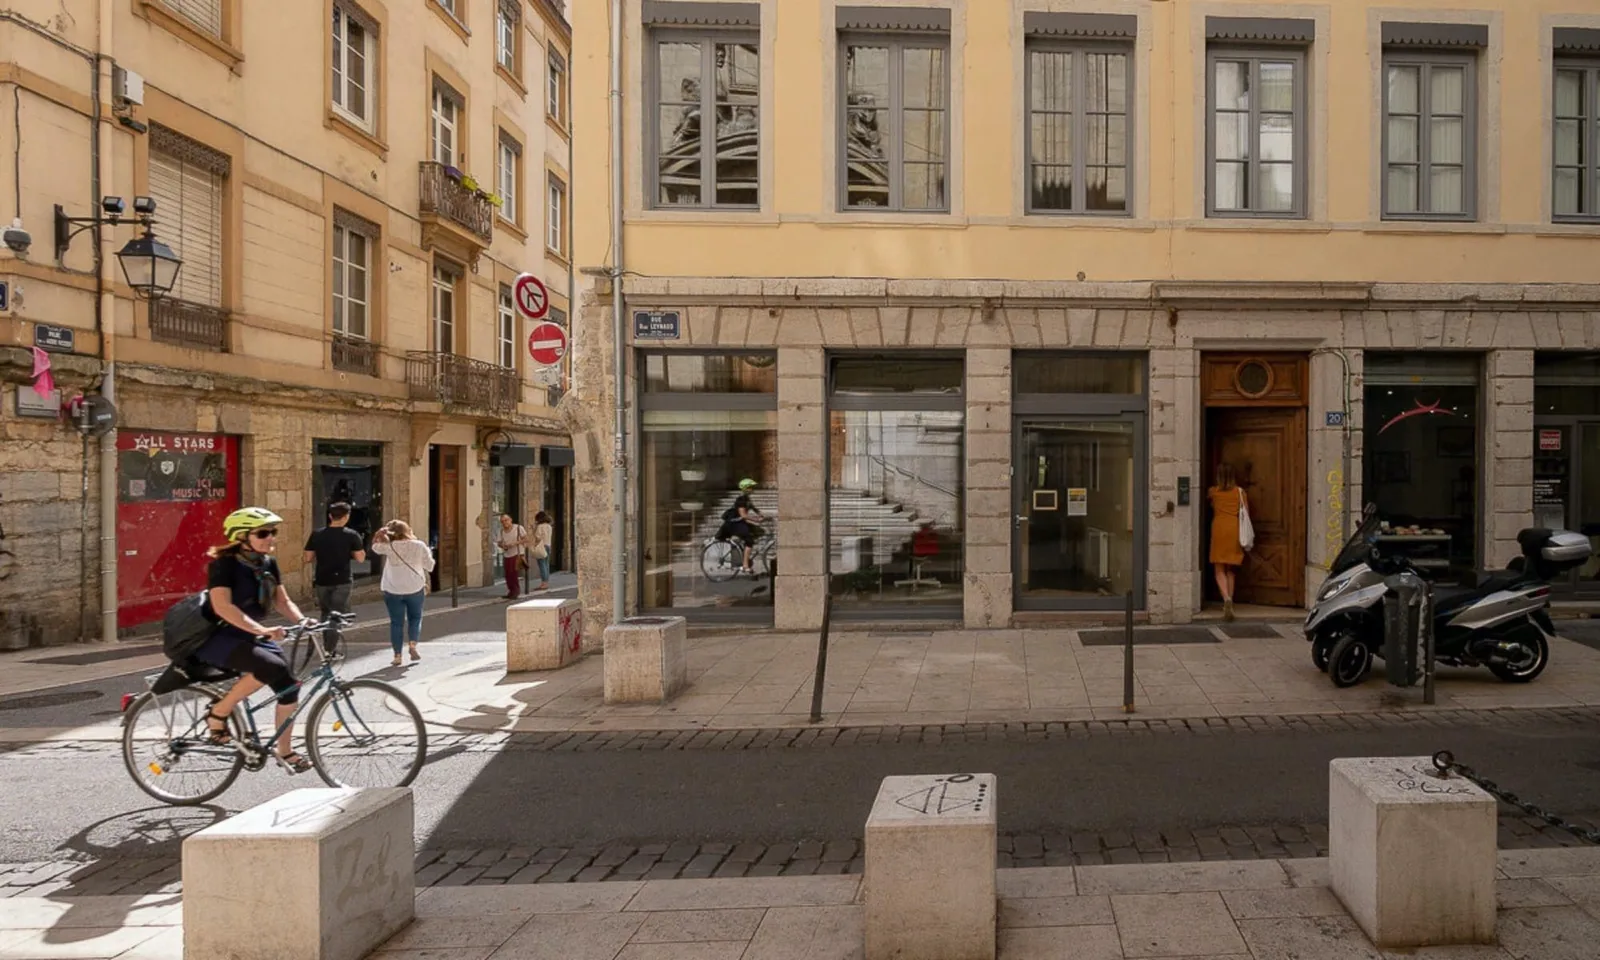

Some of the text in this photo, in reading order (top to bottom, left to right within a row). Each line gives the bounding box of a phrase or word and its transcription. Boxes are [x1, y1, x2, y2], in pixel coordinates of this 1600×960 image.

[1328, 413, 1341, 424] 20
[134, 434, 215, 449] ALL STARS
[172, 488, 201, 498] MUSIC
